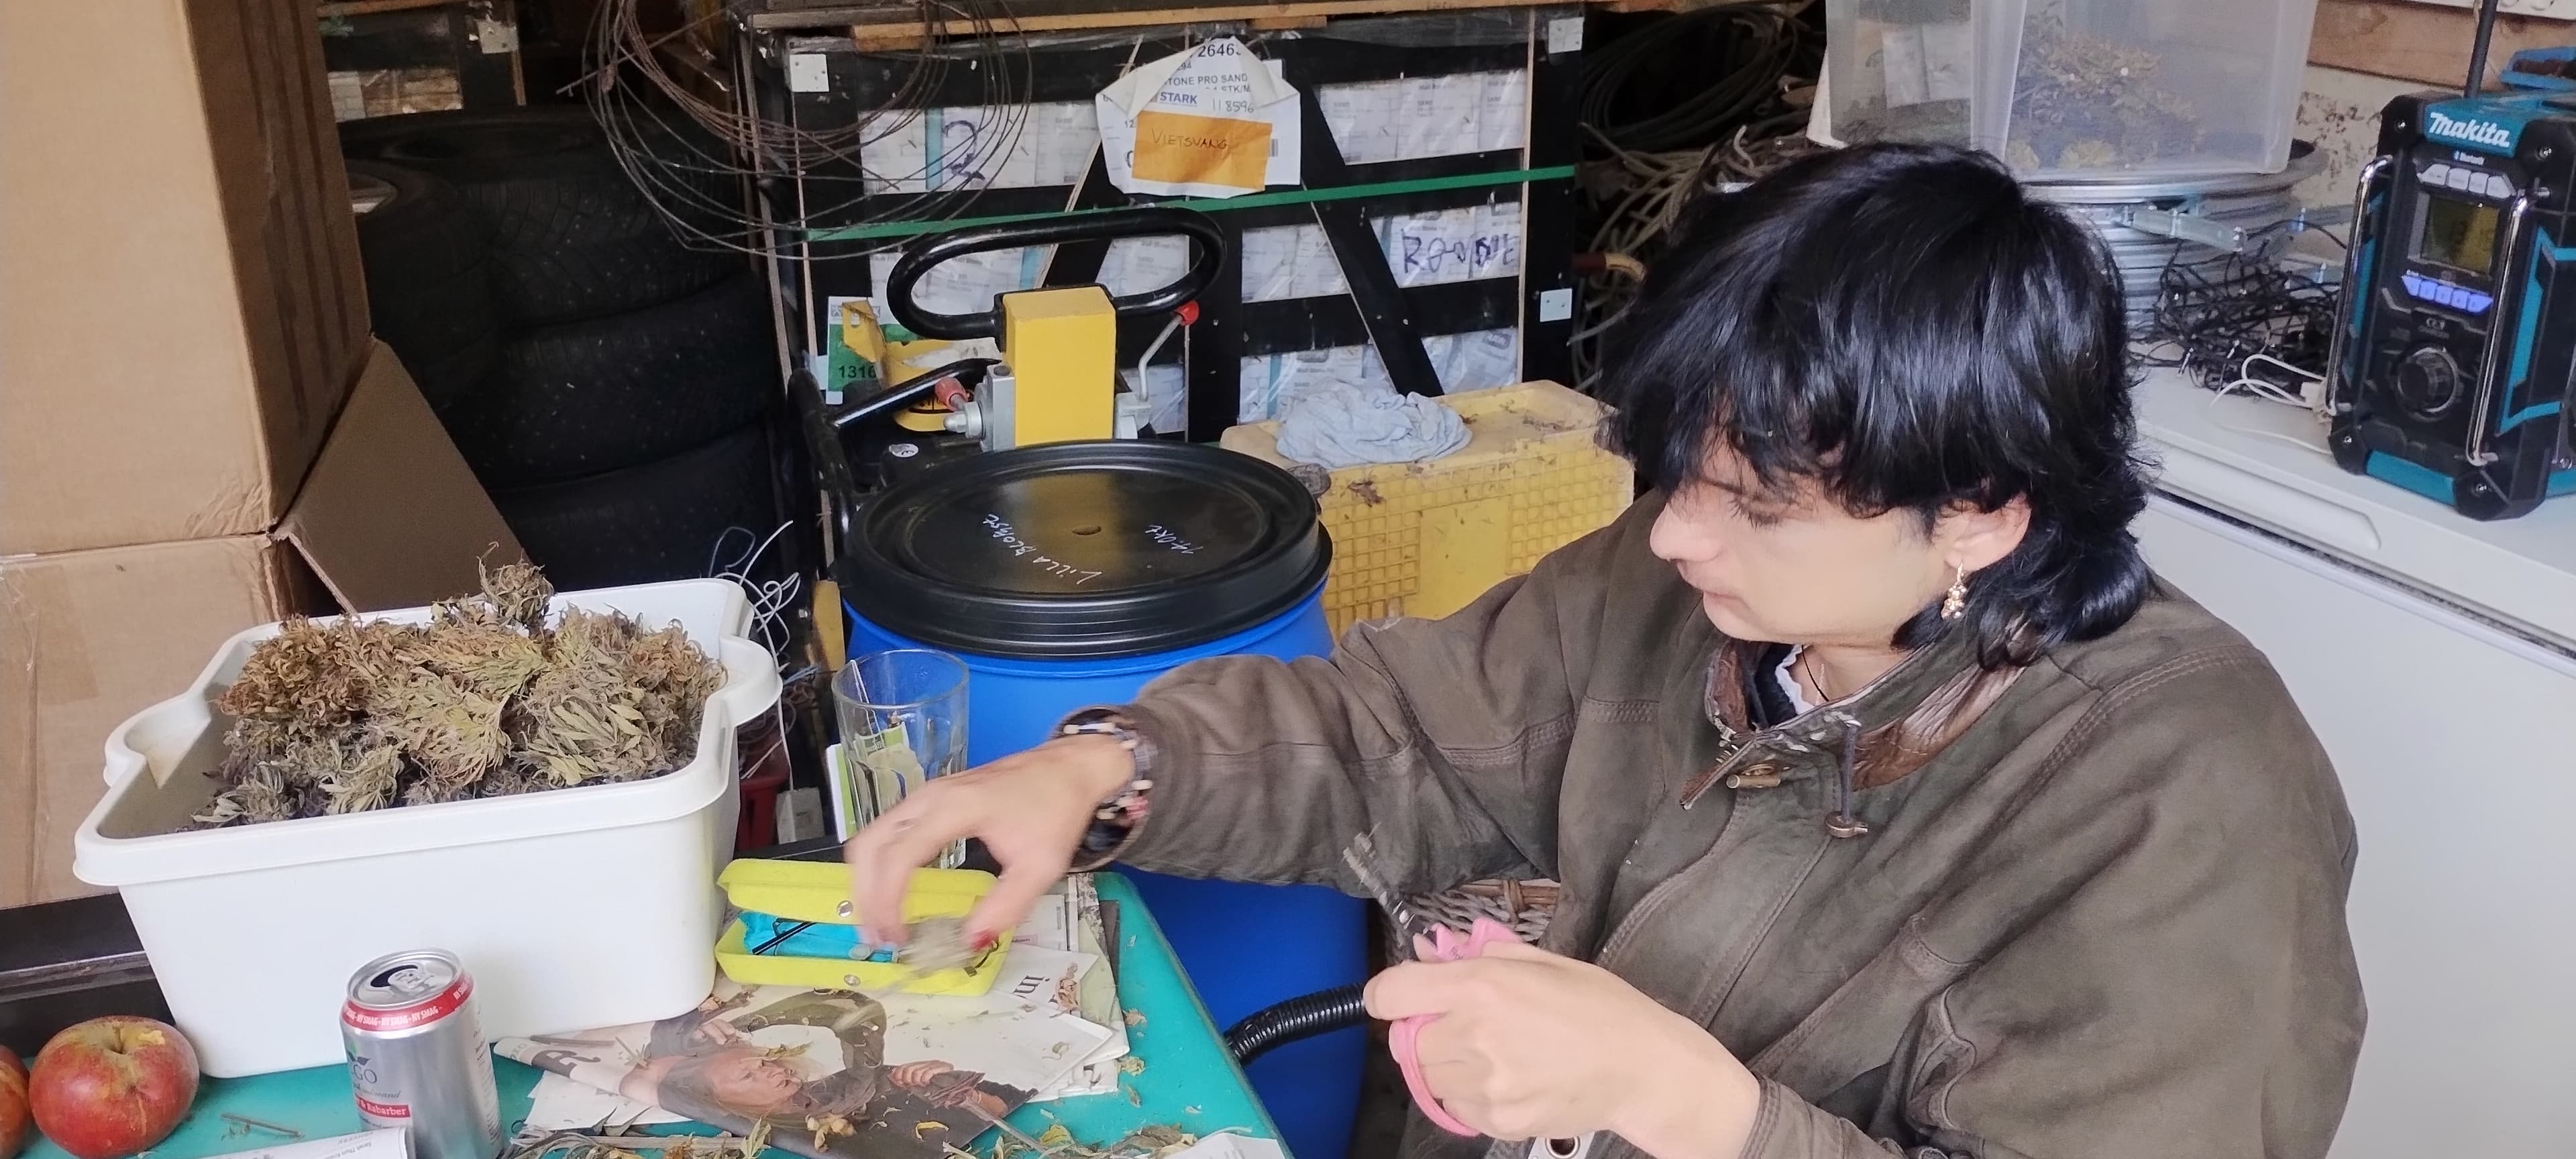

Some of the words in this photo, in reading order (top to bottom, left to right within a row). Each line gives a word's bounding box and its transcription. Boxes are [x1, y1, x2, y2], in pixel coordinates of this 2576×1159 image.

[1191, 43, 1241, 58] 2646
[1165, 76, 1195, 87] TONE
[1198, 75, 1218, 85] PRO
[1221, 73, 1248, 83] SAND
[1160, 91, 1197, 104] STARK
[2429, 112, 2510, 148] Makita
[1012, 975, 1051, 999] in
[389, 1014, 409, 1026] SMAG
[411, 1011, 421, 1022] NY
[421, 1005, 439, 1019] SMAG
[351, 1064, 378, 1084] GO
[366, 1103, 407, 1115] Rabarber
